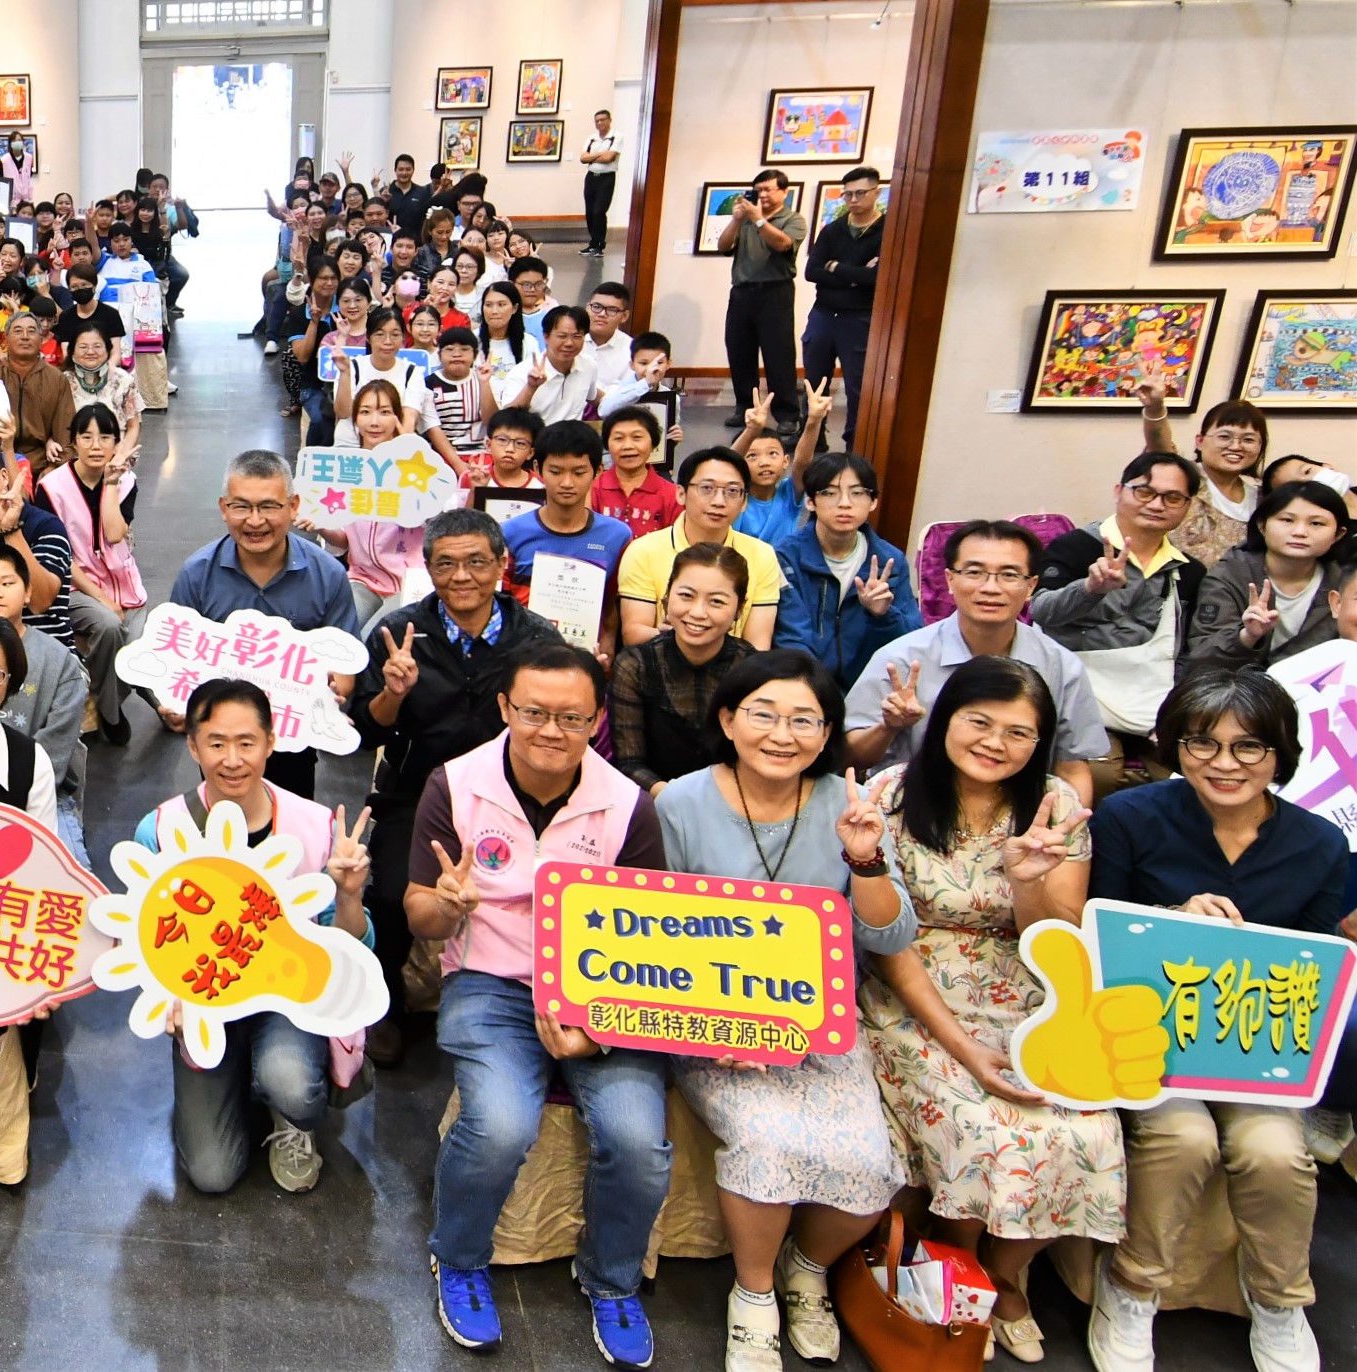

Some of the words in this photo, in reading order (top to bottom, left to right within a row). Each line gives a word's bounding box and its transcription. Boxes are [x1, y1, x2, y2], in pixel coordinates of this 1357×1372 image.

[1023, 170, 1091, 187] 第11組
[153, 616, 319, 686] 美好彰化
[274, 680, 312, 696] COUNTY
[612, 908, 755, 938] Dreams
[577, 948, 694, 992] Come
[709, 962, 816, 1006] True
[589, 1003, 808, 1053] 彰化縣特教資源中心
[1160, 955, 1322, 1055] 有夠讚
